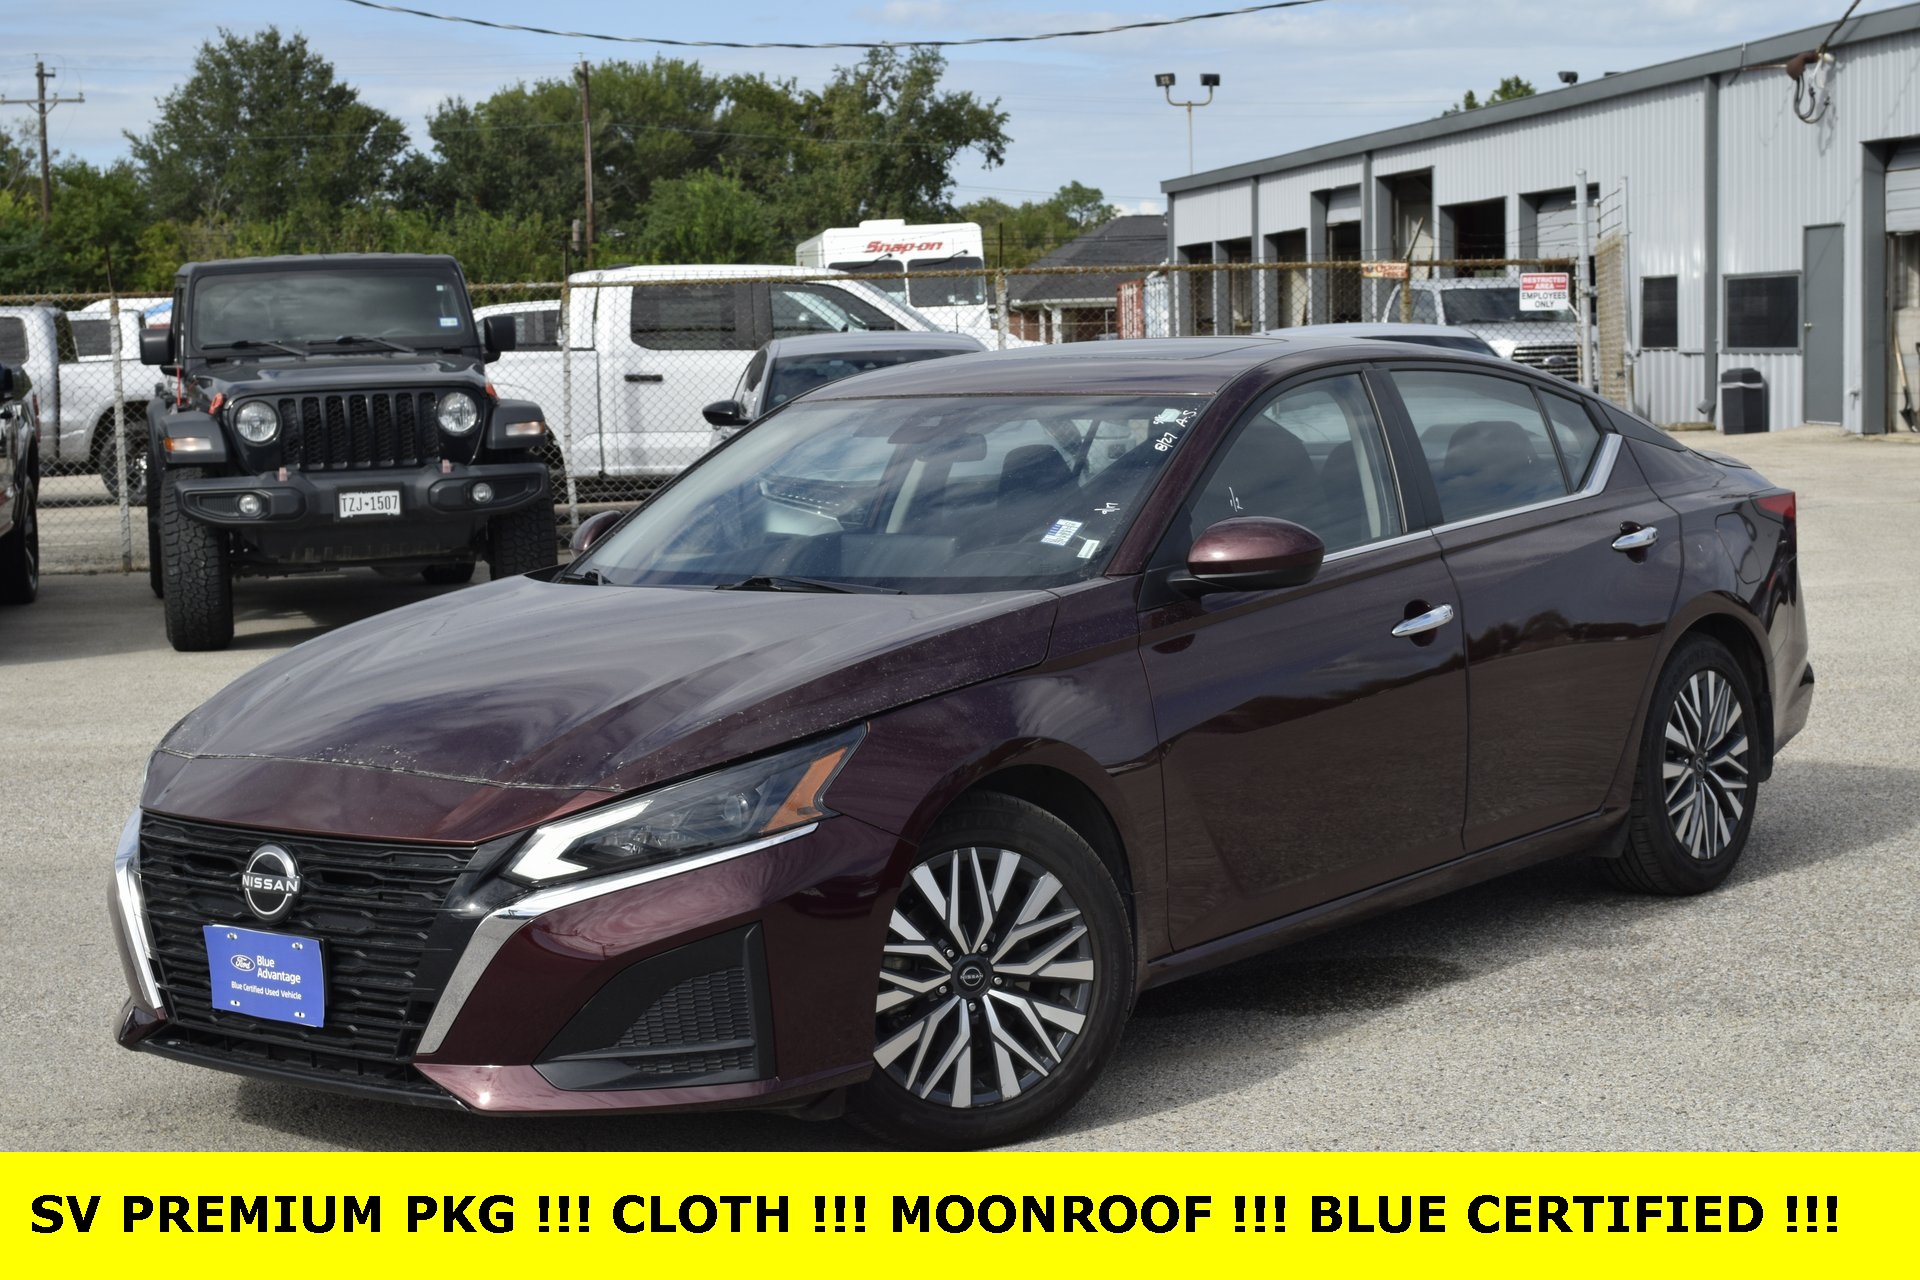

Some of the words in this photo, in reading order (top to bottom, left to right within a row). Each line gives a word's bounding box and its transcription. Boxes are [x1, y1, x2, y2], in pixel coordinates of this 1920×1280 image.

[864, 240, 943, 255] Snap-on
[1522, 276, 1566, 284] RESTRICTED
[1535, 282, 1555, 290] AREA
[1521, 291, 1567, 300] EMPLOYEES
[1534, 300, 1555, 308] ONLY
[242, 874, 298, 892] NISSAN
[256, 955, 275, 968] Blue
[257, 967, 301, 985] Advantage
[231, 980, 243, 991] Blue
[243, 983, 264, 995] Certified
[264, 986, 280, 997] Used
[280, 989, 302, 1001] Vehicle
